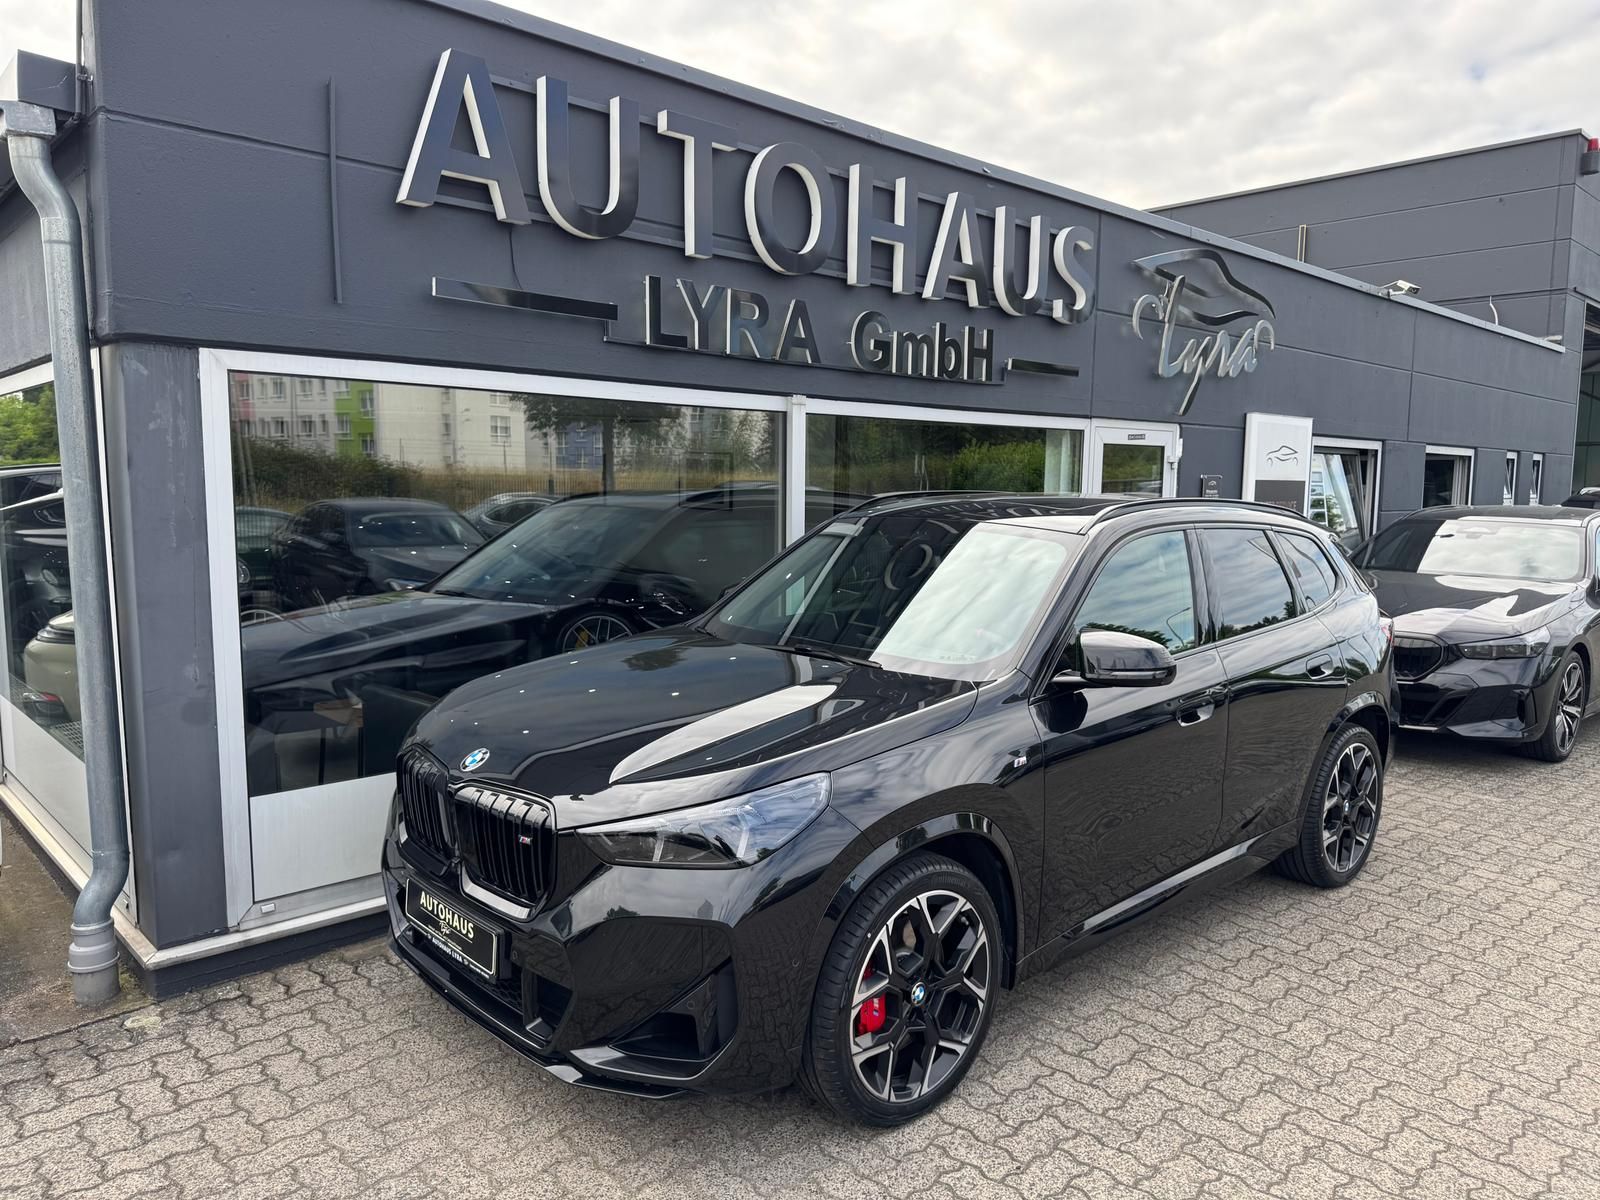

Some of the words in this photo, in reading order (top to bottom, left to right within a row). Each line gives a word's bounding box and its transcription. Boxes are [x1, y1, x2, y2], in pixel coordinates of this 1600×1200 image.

[396, 48, 1095, 325] AUTOHAUS
[645, 274, 820, 364] LYRA
[851, 309, 994, 382] GmbH
[1132, 275, 1275, 416] Lyra
[420, 891, 474, 938] AUTOHAUS
